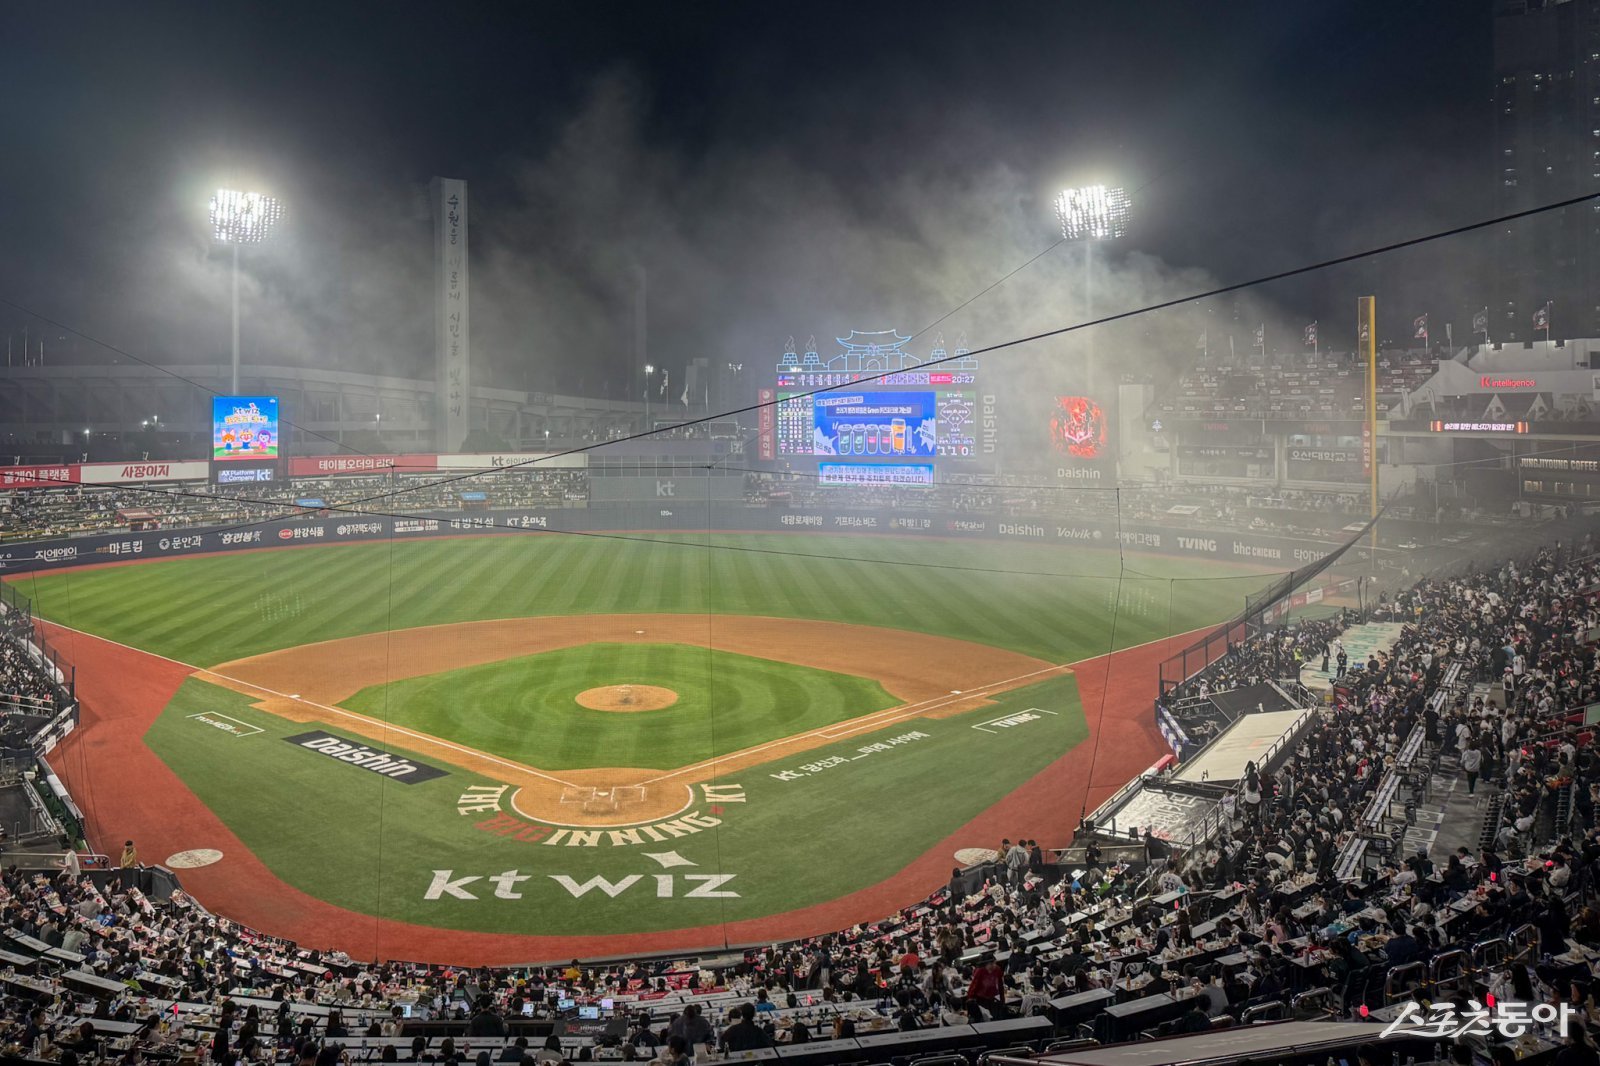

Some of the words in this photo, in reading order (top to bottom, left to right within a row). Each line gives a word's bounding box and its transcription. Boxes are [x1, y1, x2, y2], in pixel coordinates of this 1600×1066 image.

[951, 375, 975, 384] 20:27
[1492, 378, 1536, 388] intelligence
[983, 395, 997, 453] Daishin
[491, 456, 504, 467] kt
[1291, 450, 1346, 462] 오산대학교
[318, 458, 374, 470] 테이블오더의
[375, 457, 395, 469] 리더
[1571, 459, 1598, 471] COFFEE
[3, 470, 37, 484] 풀케어
[39, 467, 70, 482] 플랫폼
[121, 464, 170, 479] 사장이지
[257, 469, 271, 481] kt
[1057, 468, 1101, 479] Daishin
[656, 481, 675, 496] kt
[450, 517, 494, 529] 대방건설
[507, 517, 519, 526] KT
[780, 514, 823, 526] 대광로제비앙
[834, 516, 862, 527] 기프티쇼
[863, 517, 878, 527] 비즈
[294, 526, 324, 538] 한강식품
[999, 523, 1044, 537] Daishin
[1056, 527, 1091, 539] Volvik
[109, 540, 143, 555] 마트킹
[172, 535, 202, 549] 문안과
[1177, 537, 1217, 551] TVING
[1233, 541, 1251, 555] bhc
[1252, 547, 1281, 560] CHICKEN
[990, 712, 1041, 729] TVING
[301, 737, 418, 777] Daishin
[457, 784, 510, 816] THE
[700, 783, 746, 803] KT
[473, 812, 555, 843] BIG
[542, 810, 722, 847] INNING
[423, 869, 532, 900] kt
[547, 860, 742, 899] wiz
